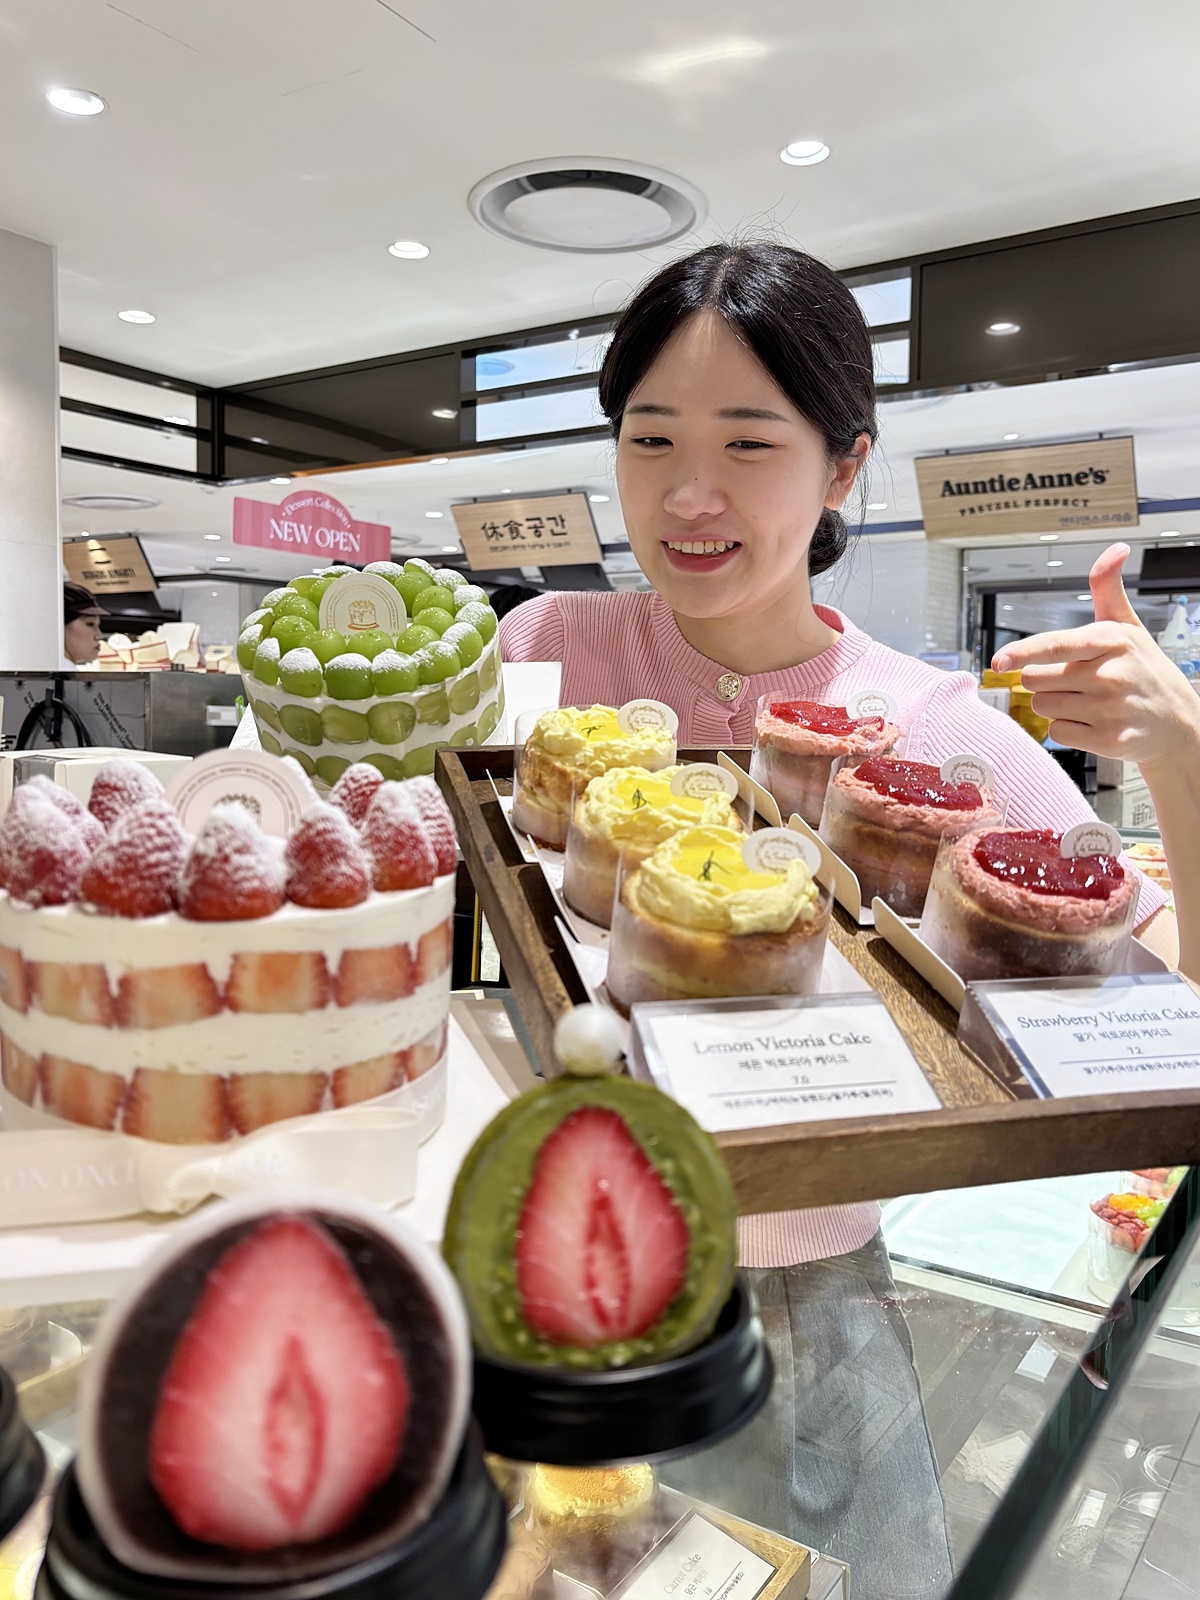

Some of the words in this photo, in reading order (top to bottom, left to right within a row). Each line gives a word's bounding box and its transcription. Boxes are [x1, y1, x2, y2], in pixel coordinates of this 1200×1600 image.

[960, 501, 1019, 516] PRETZEL
[1025, 499, 1090, 508] PERFECT
[269, 518, 313, 545] NEW
[315, 527, 361, 553] OPEN
[1017, 1014, 1098, 1029] Strawberry
[1100, 1009, 1161, 1024] Victoria
[1162, 1007, 1200, 1021] Cake
[693, 1039, 754, 1056] Lemon
[755, 1033, 826, 1051] Victoria
[828, 1031, 872, 1047] Cake
[1073, 1032, 1096, 1043] 딸기
[1099, 1028, 1140, 1041] 빅토리아
[1141, 1028, 1172, 1039] 케이크
[814, 1053, 849, 1065] 케이크
[664, 1571, 687, 1594] Carrot
[682, 1554, 702, 1573] Cake
